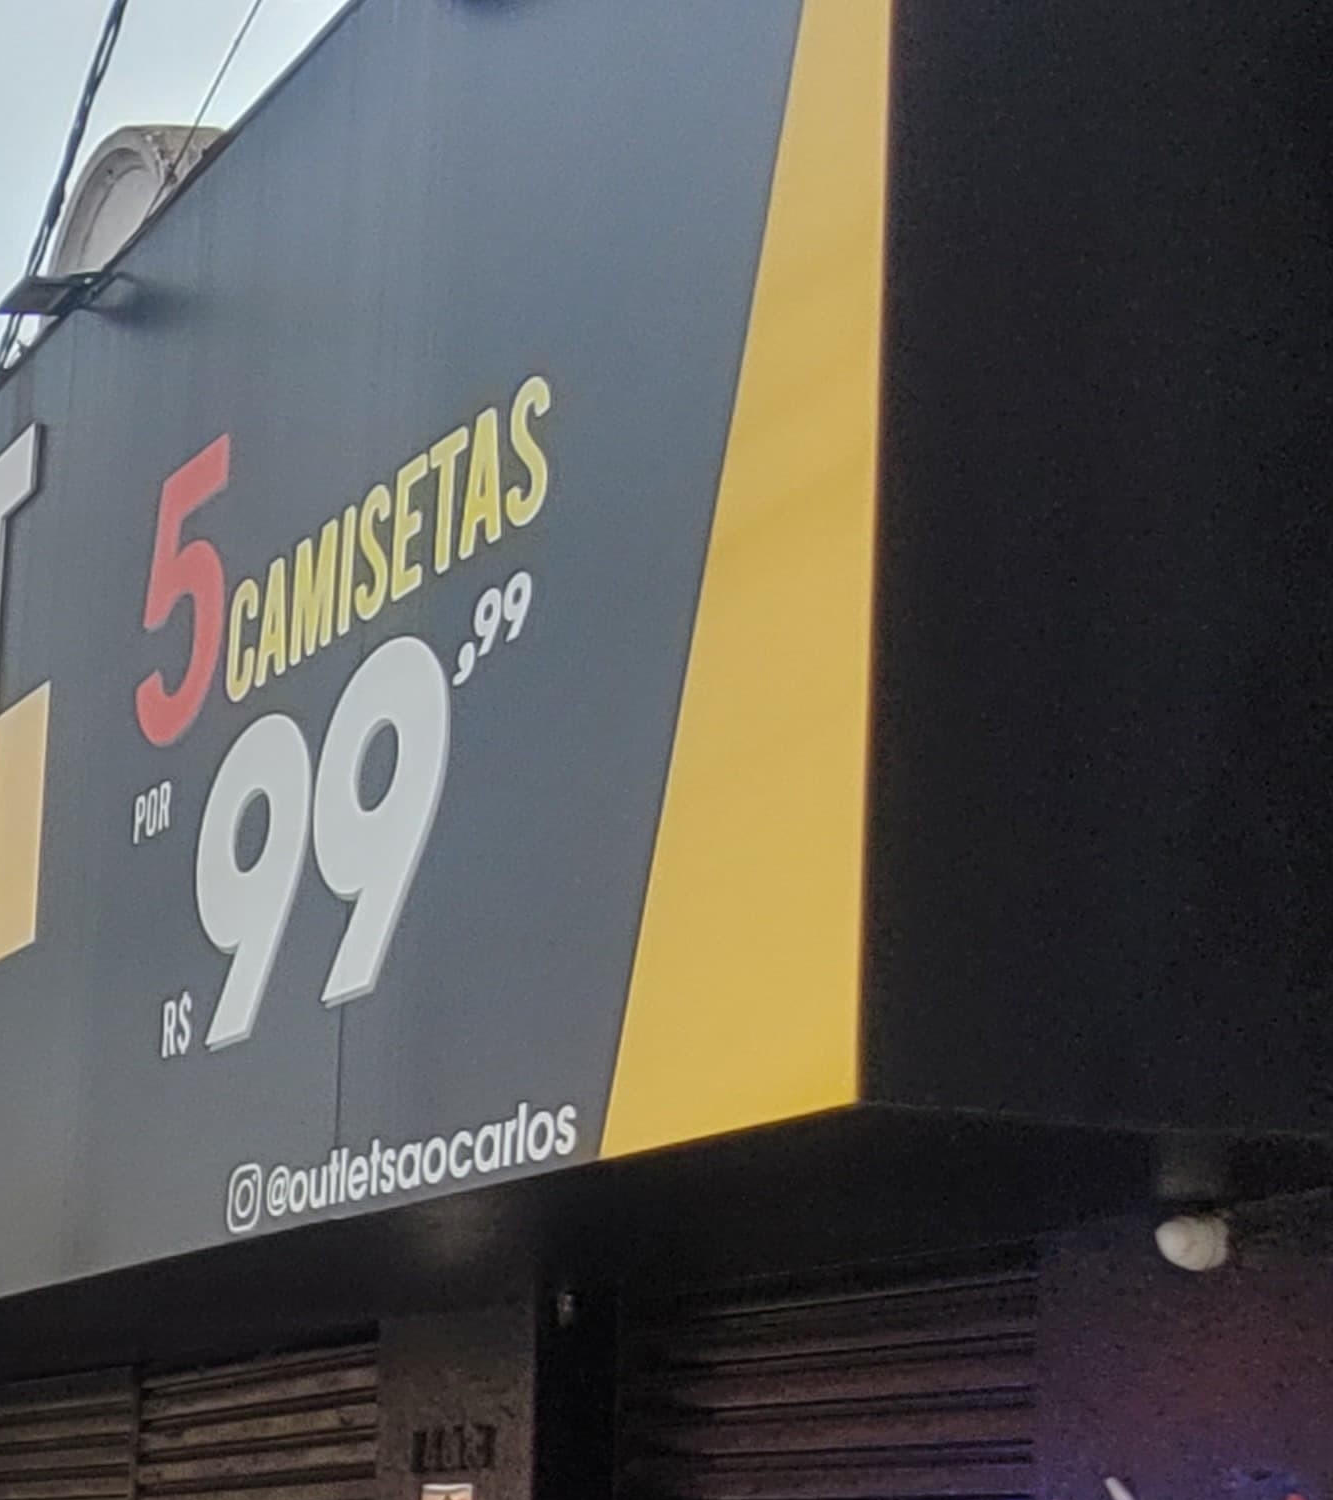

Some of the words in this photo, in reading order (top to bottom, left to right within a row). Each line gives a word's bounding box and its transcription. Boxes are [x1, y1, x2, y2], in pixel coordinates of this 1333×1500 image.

[135, 433, 230, 745] 5
[225, 375, 551, 703] CAMISETAS
[134, 780, 172, 845] POR
[160, 989, 192, 1059] R$
[267, 1101, 577, 1217] @outletsaocarlos
